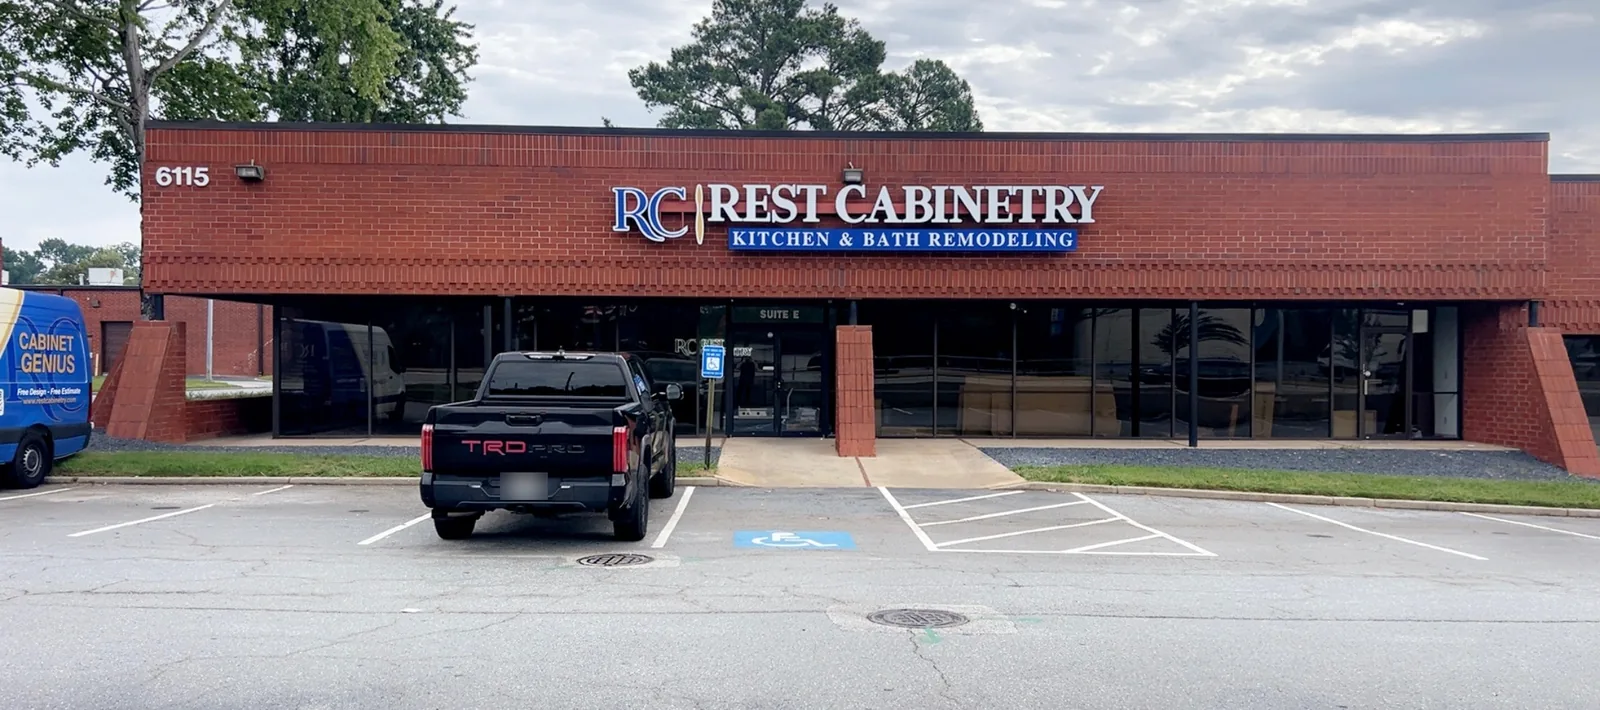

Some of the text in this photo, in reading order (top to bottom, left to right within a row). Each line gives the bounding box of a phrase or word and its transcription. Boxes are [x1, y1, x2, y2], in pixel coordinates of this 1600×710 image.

[155, 166, 210, 187] 6115
[612, 183, 1105, 243] RC REST CABINETRY
[731, 230, 1074, 248] KITCHEN & BATH REMODELING
[759, 309, 800, 320] SUITE E
[19, 331, 74, 352] CABINET
[20, 352, 76, 374] GENIUS
[17, 387, 29, 396] Free
[30, 387, 47, 397] Design
[50, 387, 61, 395] Free
[61, 386, 81, 395] Estimate
[461, 440, 586, 456] TRD PRO
